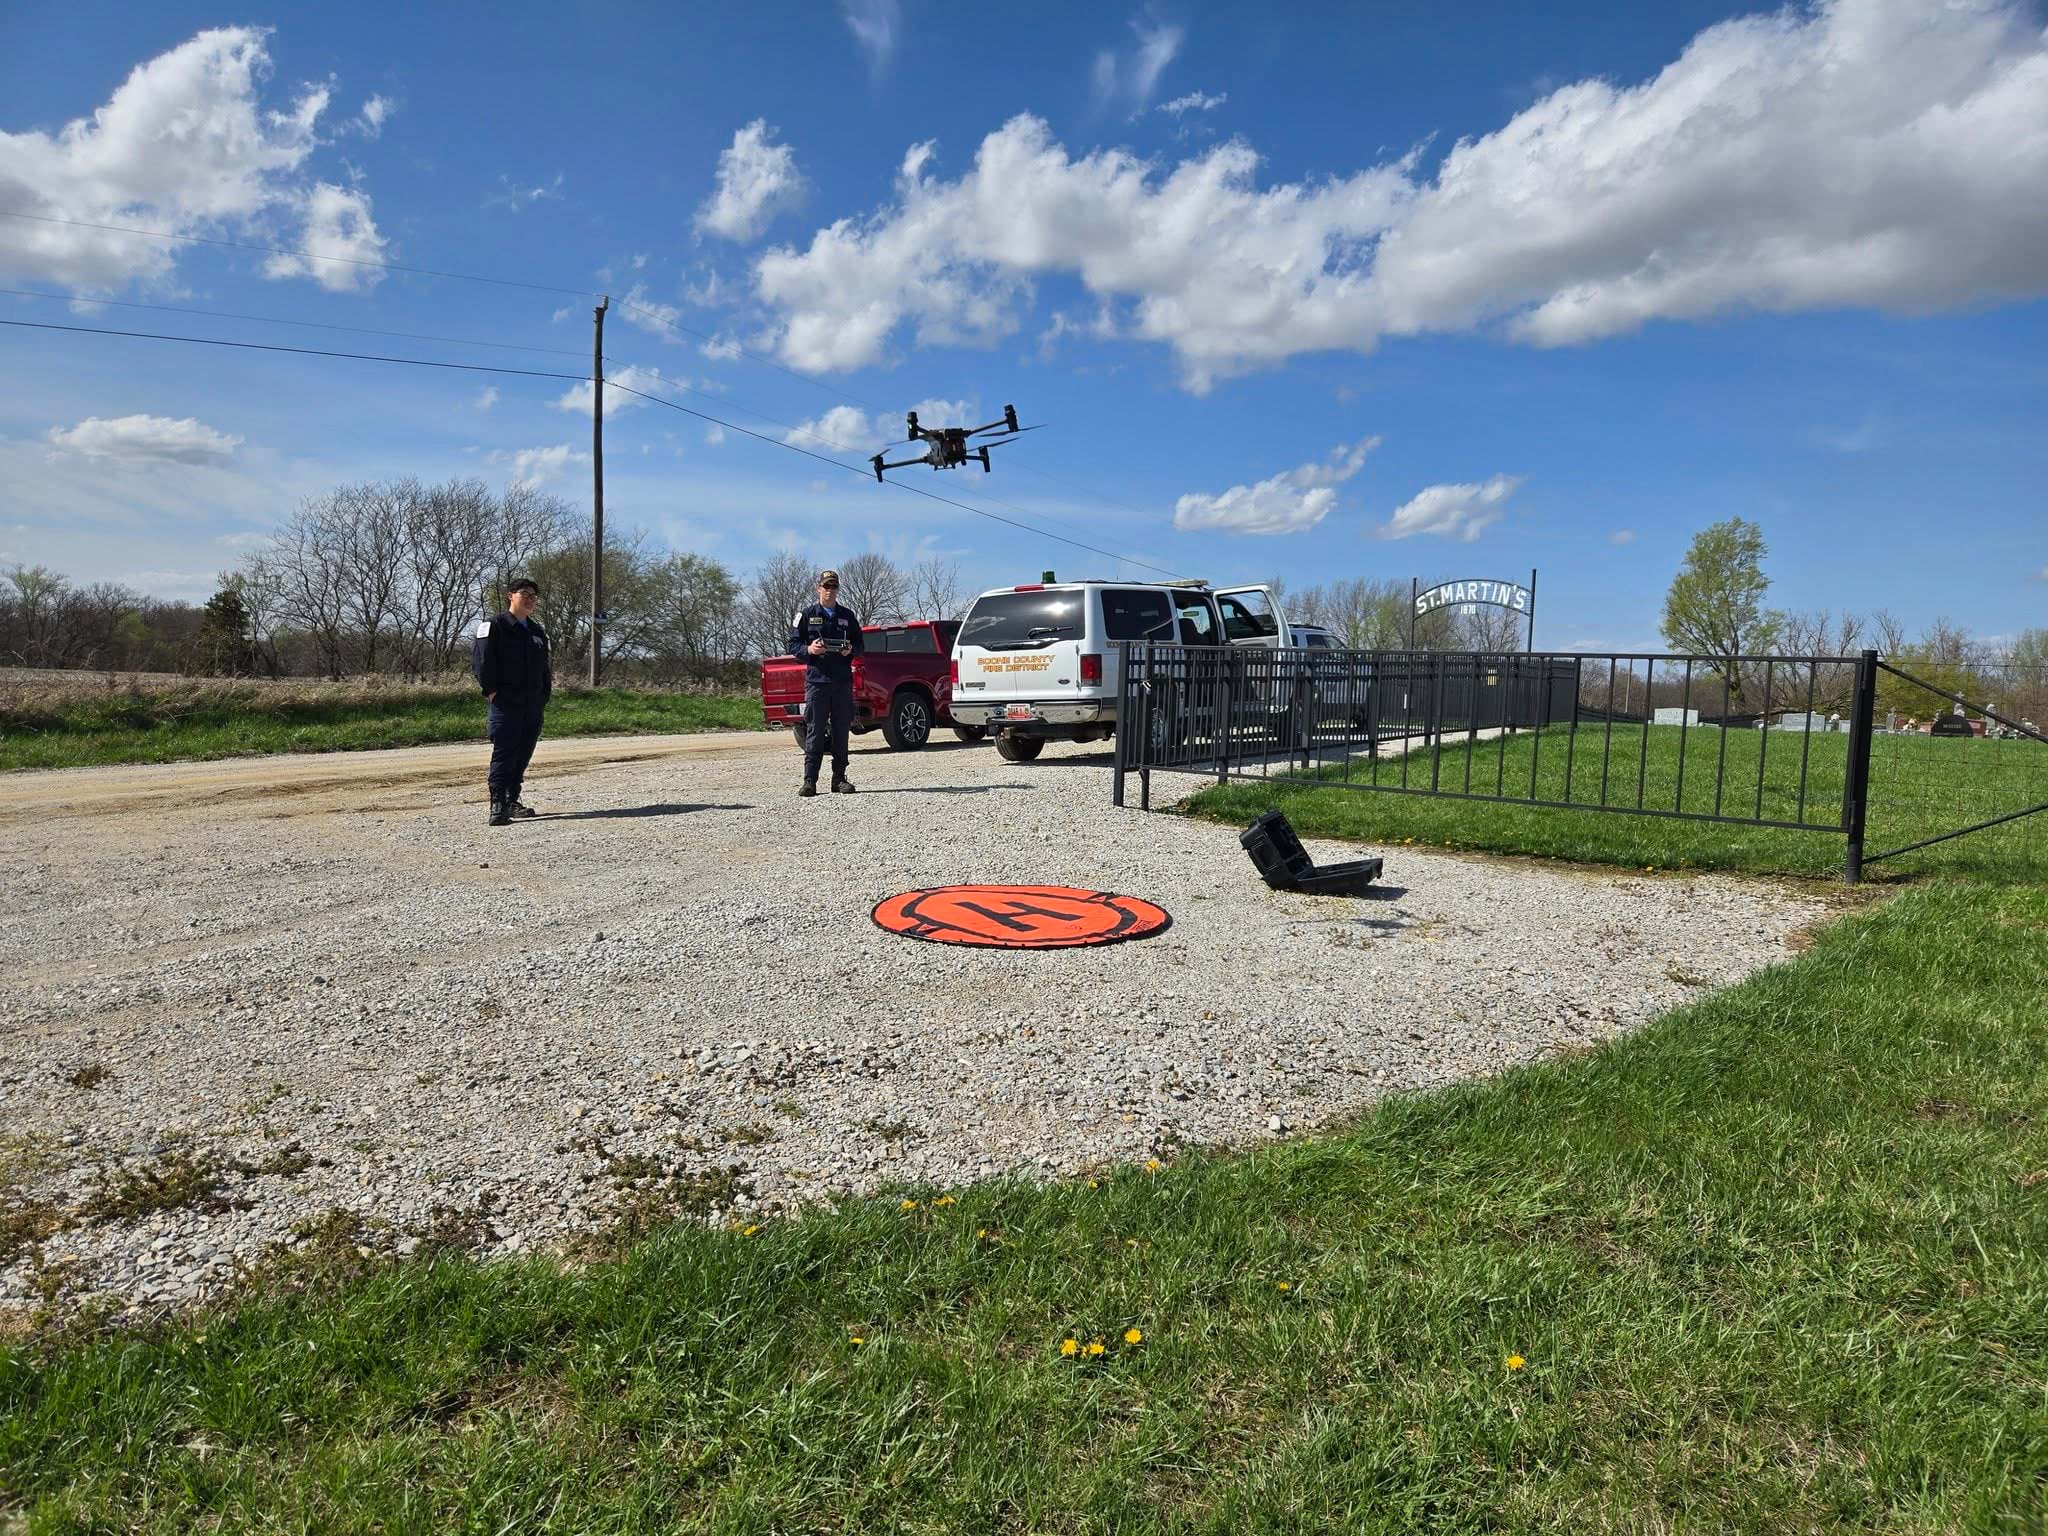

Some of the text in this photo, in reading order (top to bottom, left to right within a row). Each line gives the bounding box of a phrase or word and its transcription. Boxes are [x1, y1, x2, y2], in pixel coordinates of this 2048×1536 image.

[976, 654, 1056, 665] BOONE COUNTY
[983, 663, 1050, 673] FIRE DISTRICT
